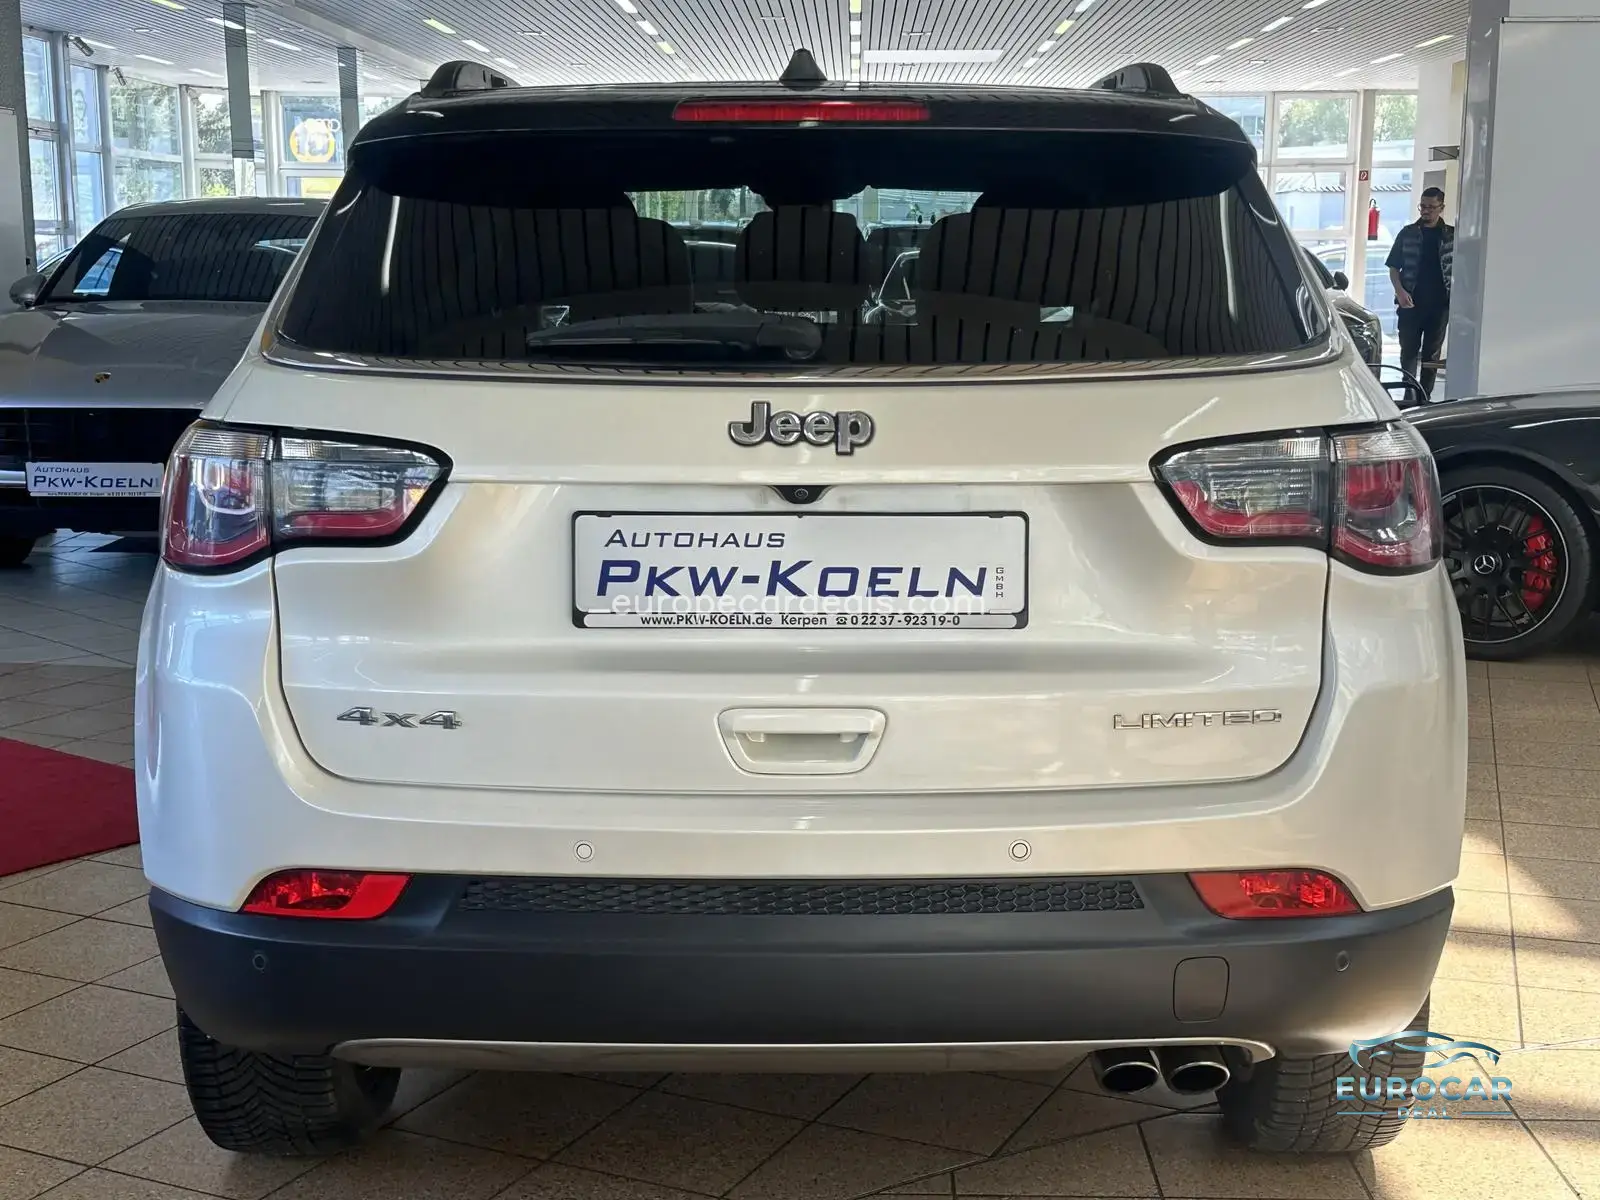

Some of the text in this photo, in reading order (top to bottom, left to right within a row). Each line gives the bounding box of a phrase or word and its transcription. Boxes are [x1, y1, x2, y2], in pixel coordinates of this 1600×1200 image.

[729, 400, 875, 456] Jeep
[604, 529, 785, 547] AUTOHAUS
[597, 560, 987, 597] PKW-KOELN
[640, 615, 773, 625] www.PKW-KOELN.de
[781, 615, 827, 628] Kerpen
[336, 706, 463, 729] 4x4
[1113, 708, 1282, 729] LIMITED
